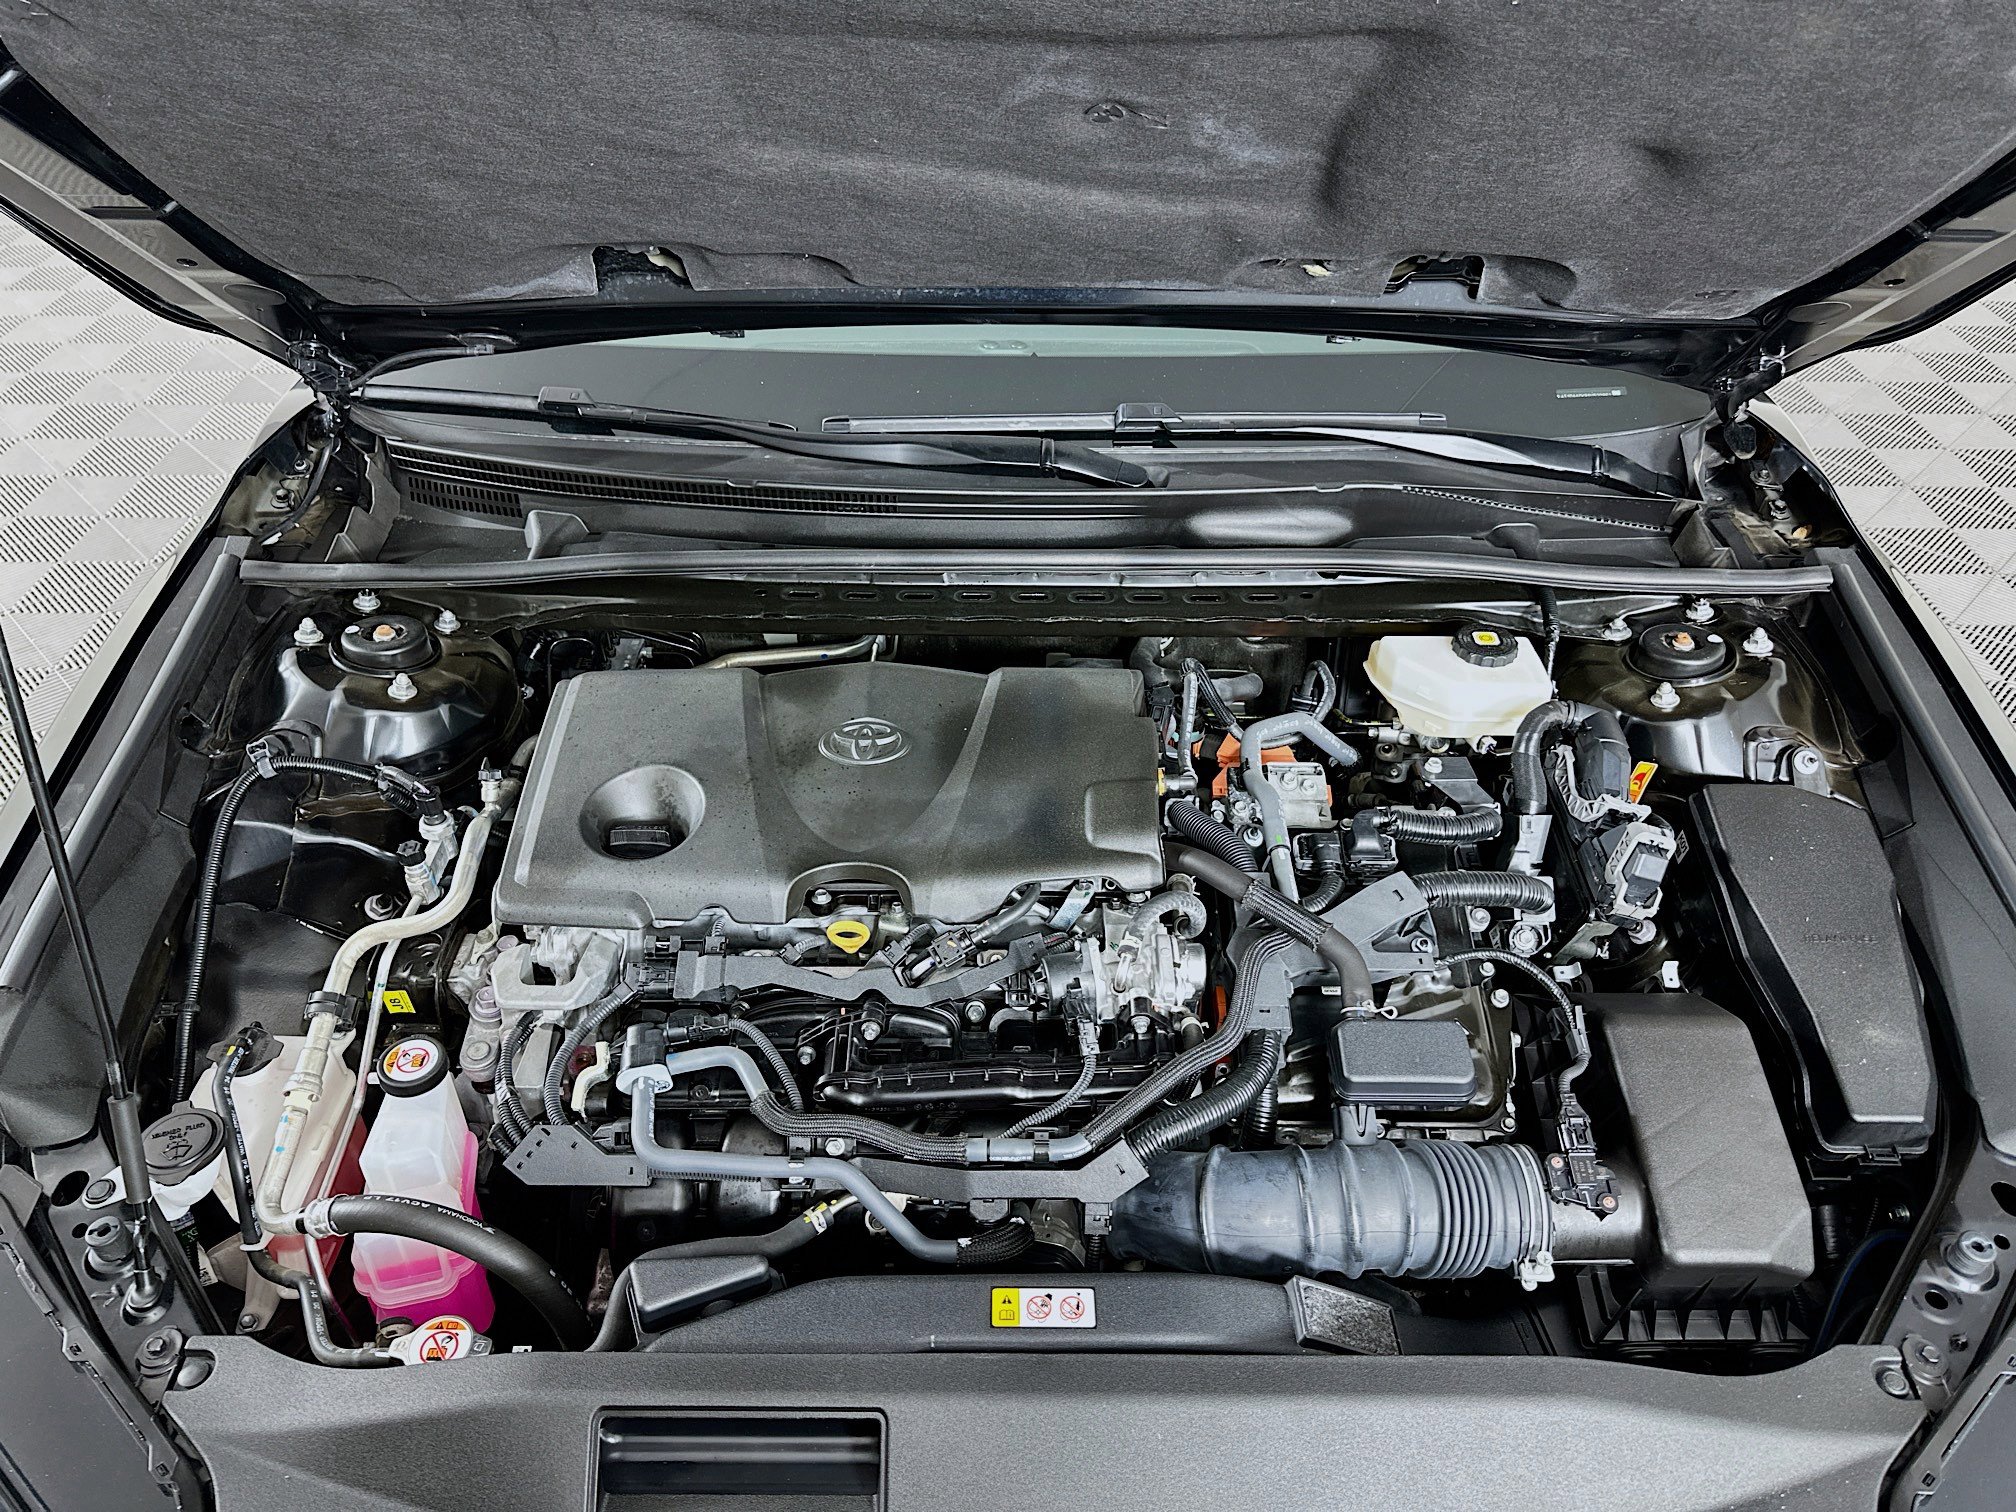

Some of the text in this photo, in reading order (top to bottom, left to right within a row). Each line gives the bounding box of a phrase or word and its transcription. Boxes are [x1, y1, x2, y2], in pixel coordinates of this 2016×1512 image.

[389, 998, 404, 1010] J8
[227, 1057, 240, 1074] WATER
[437, 1206, 484, 1229] YOKOHAMA
